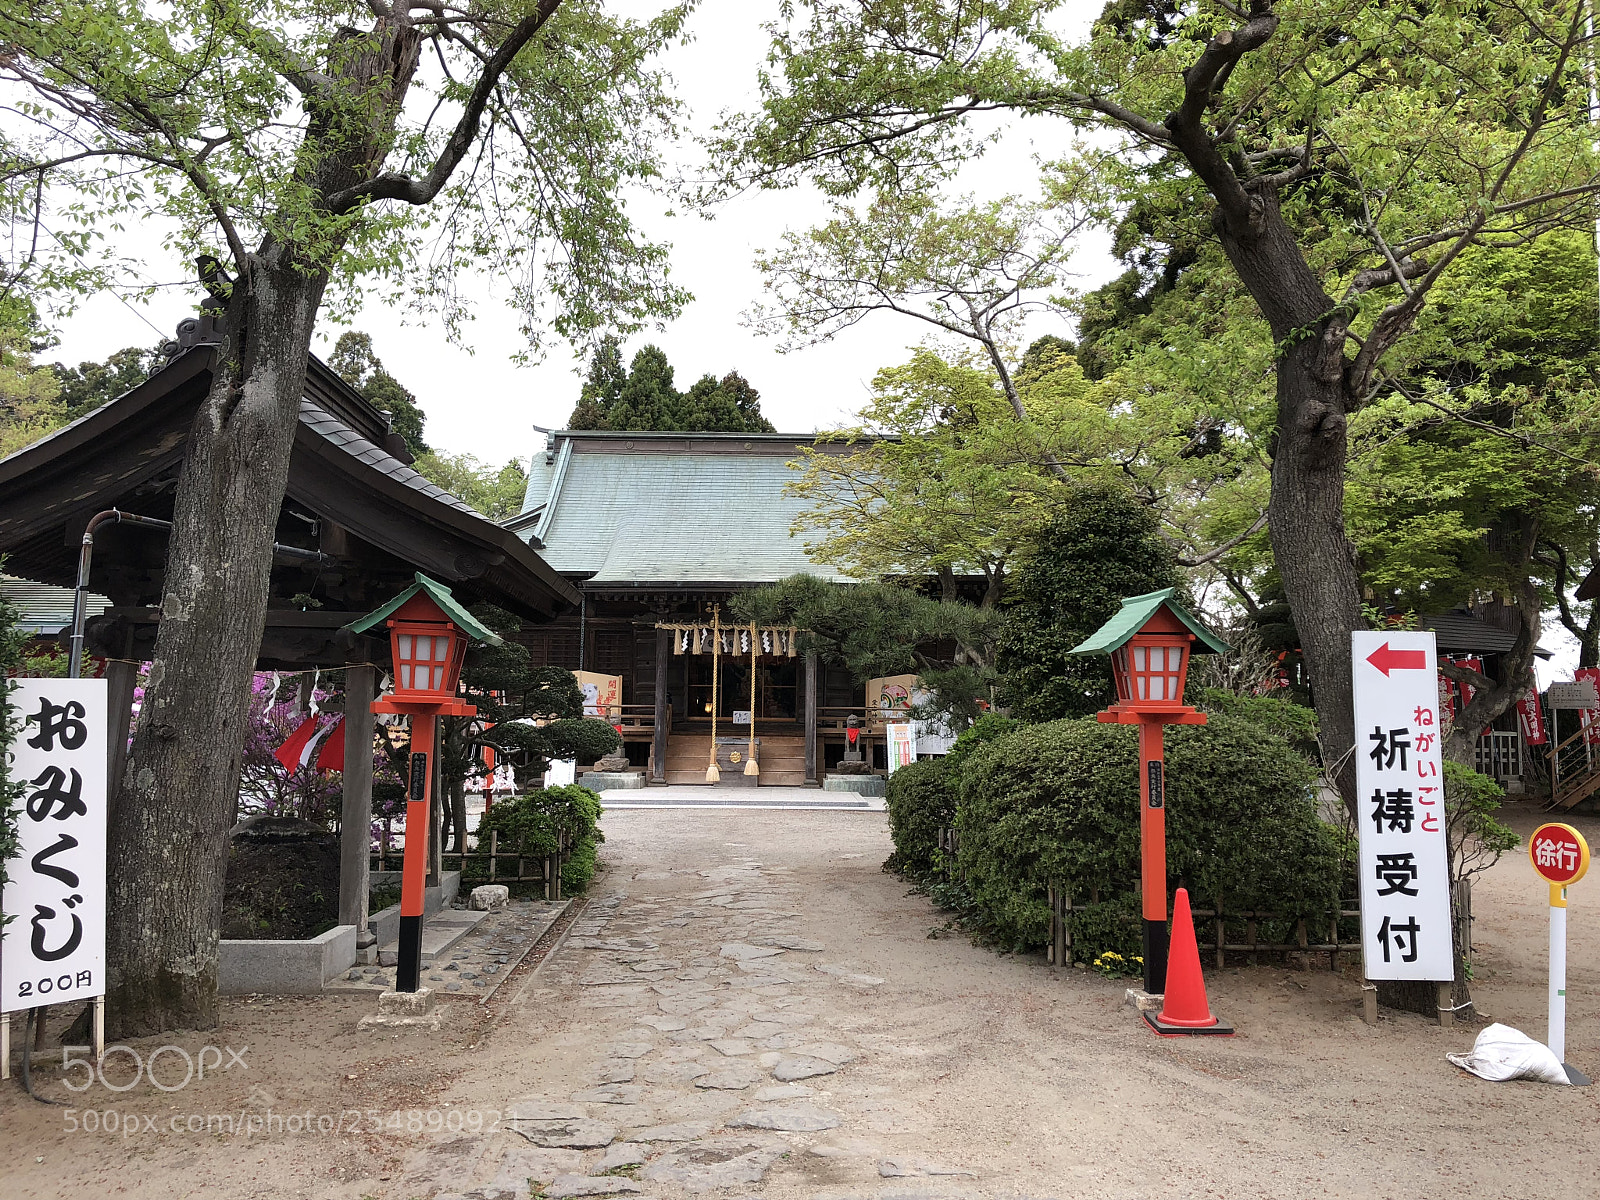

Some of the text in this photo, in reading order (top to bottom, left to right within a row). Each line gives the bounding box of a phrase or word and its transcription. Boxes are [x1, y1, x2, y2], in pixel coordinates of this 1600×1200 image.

[26, 697, 87, 961] おみくじ
[1413, 705, 1439, 832] ねがいごと
[1369, 726, 1420, 962] 祈祷受付
[1535, 837, 1578, 871] 徐行
[18, 970, 92, 997] 200円
